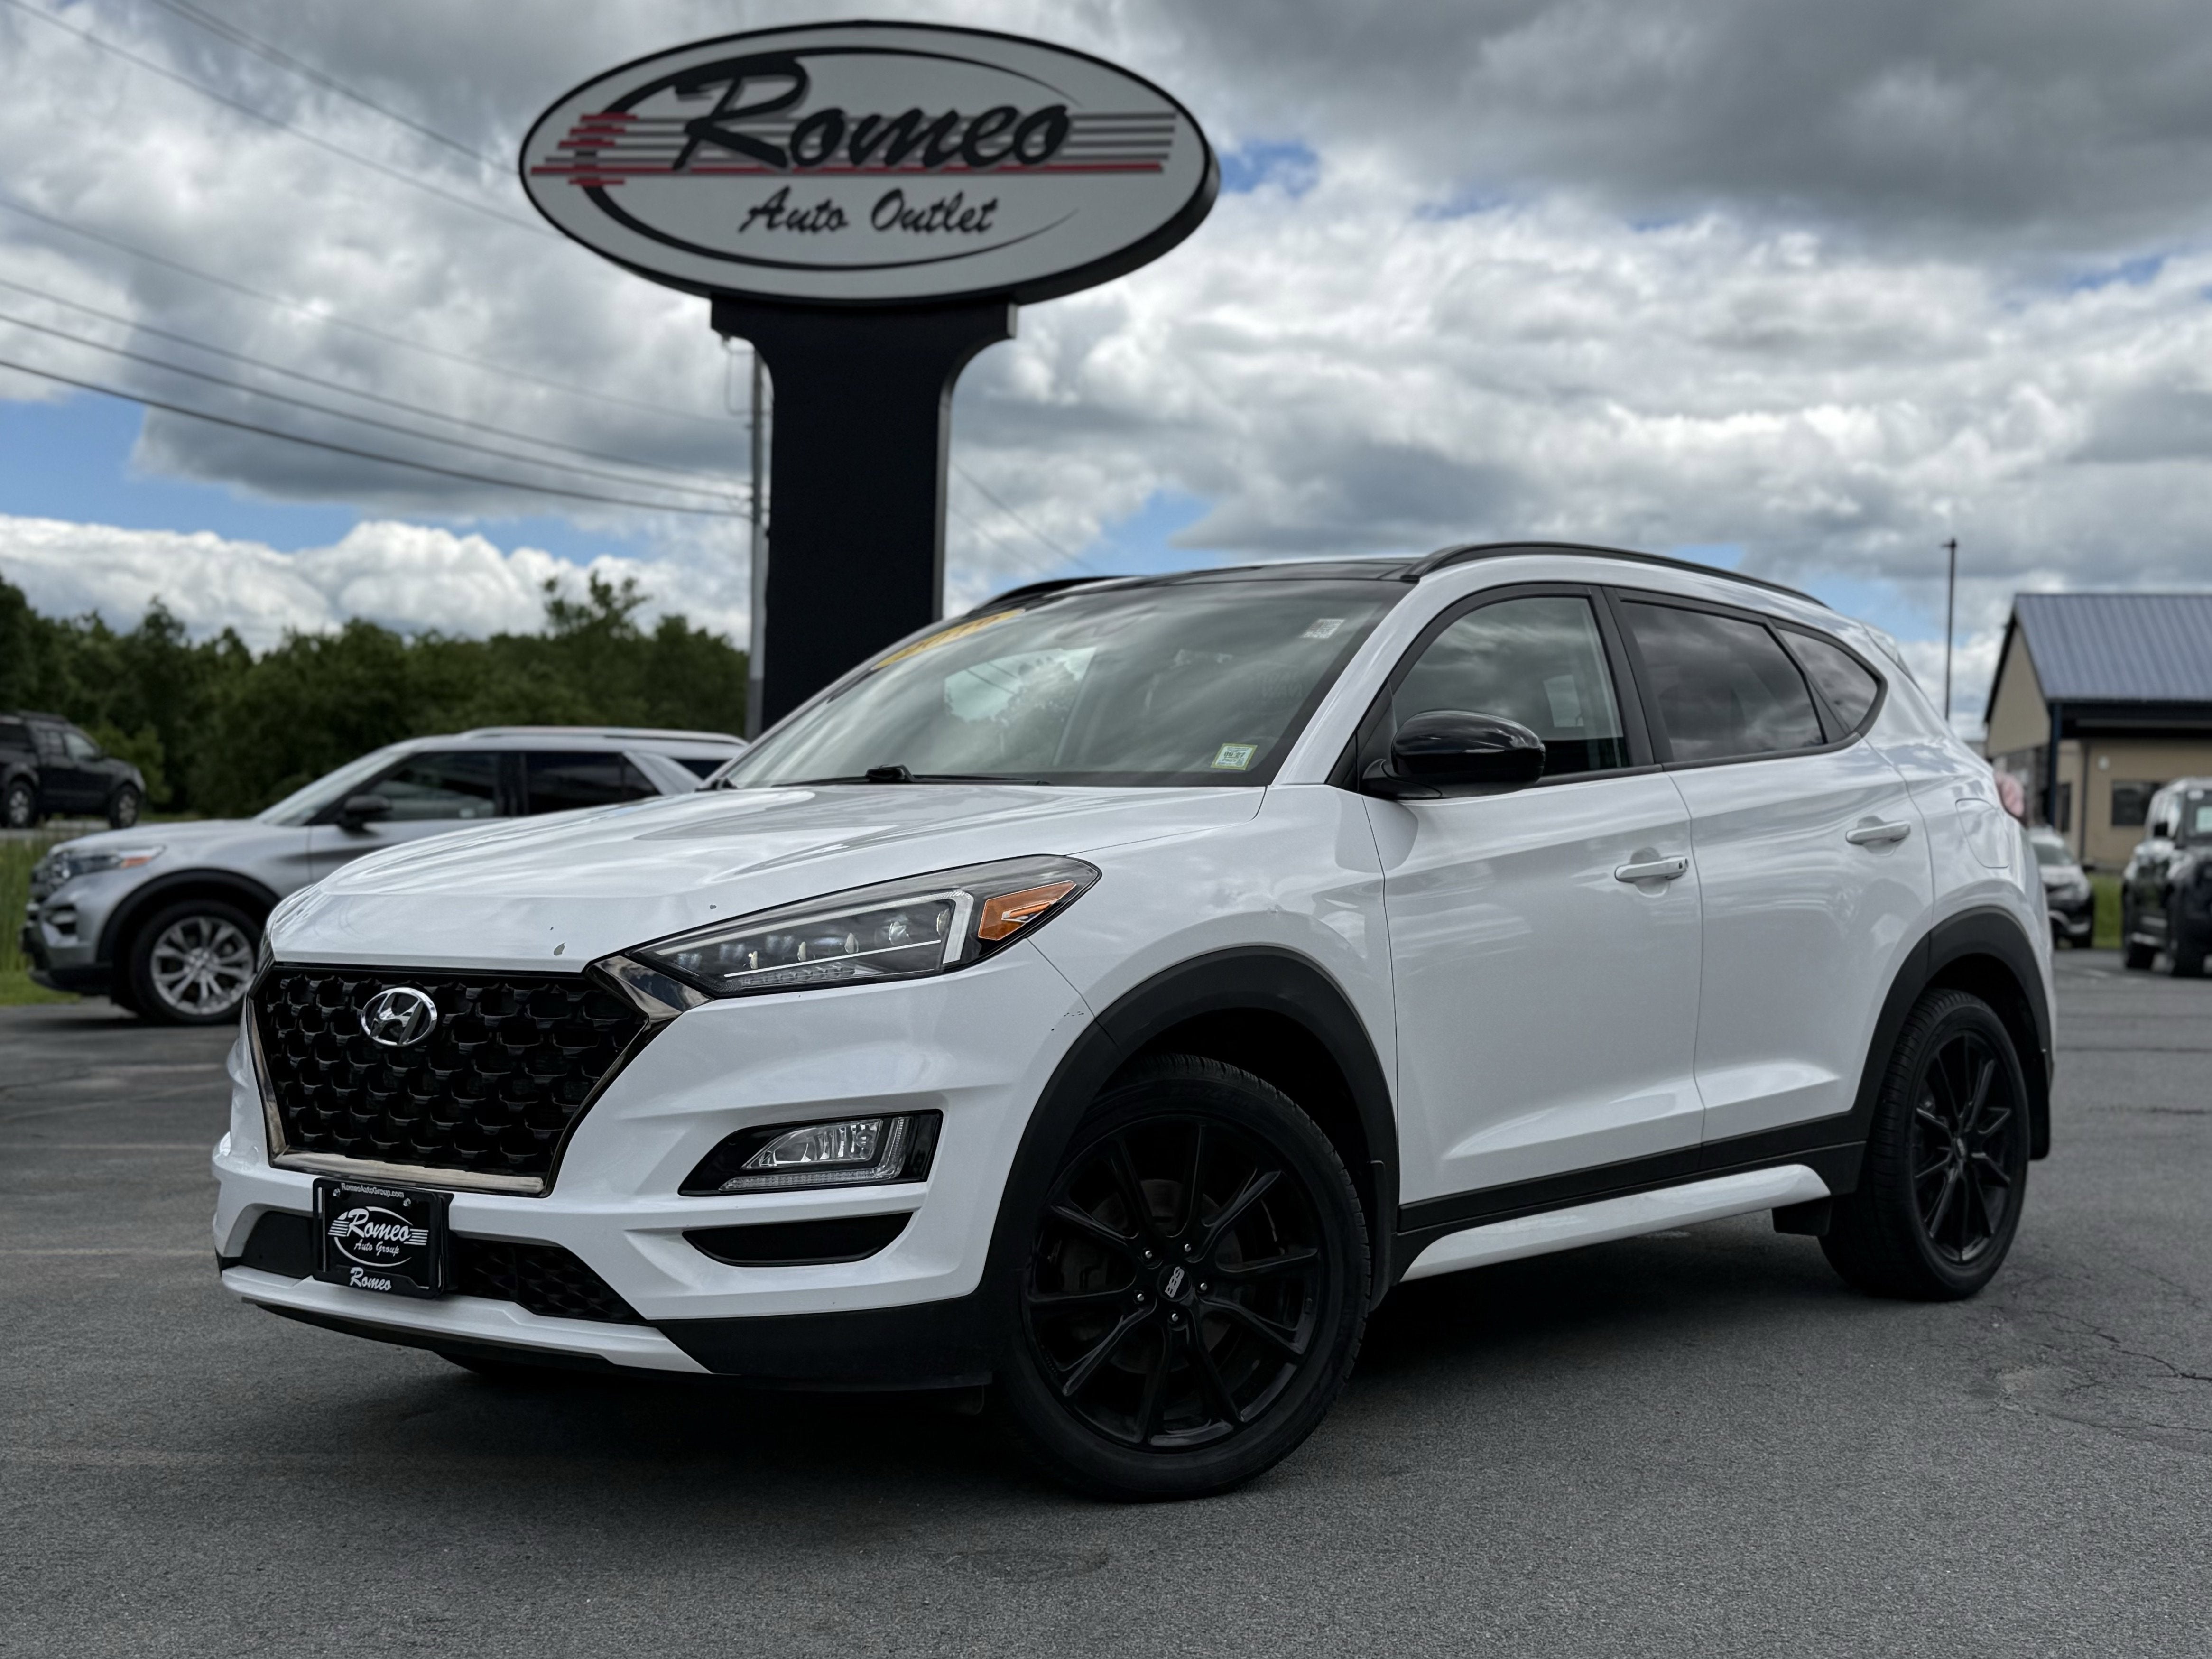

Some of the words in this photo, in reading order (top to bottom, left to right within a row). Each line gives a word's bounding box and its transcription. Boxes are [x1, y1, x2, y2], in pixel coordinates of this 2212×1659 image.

[672, 54, 1070, 172] Romeo
[738, 185, 849, 234] Auto
[870, 187, 998, 234] Outlet
[347, 1208, 411, 1241] Romeo
[354, 1239, 373, 1251] Auto
[376, 1242, 400, 1256] Group
[350, 1267, 391, 1291] Romeo
